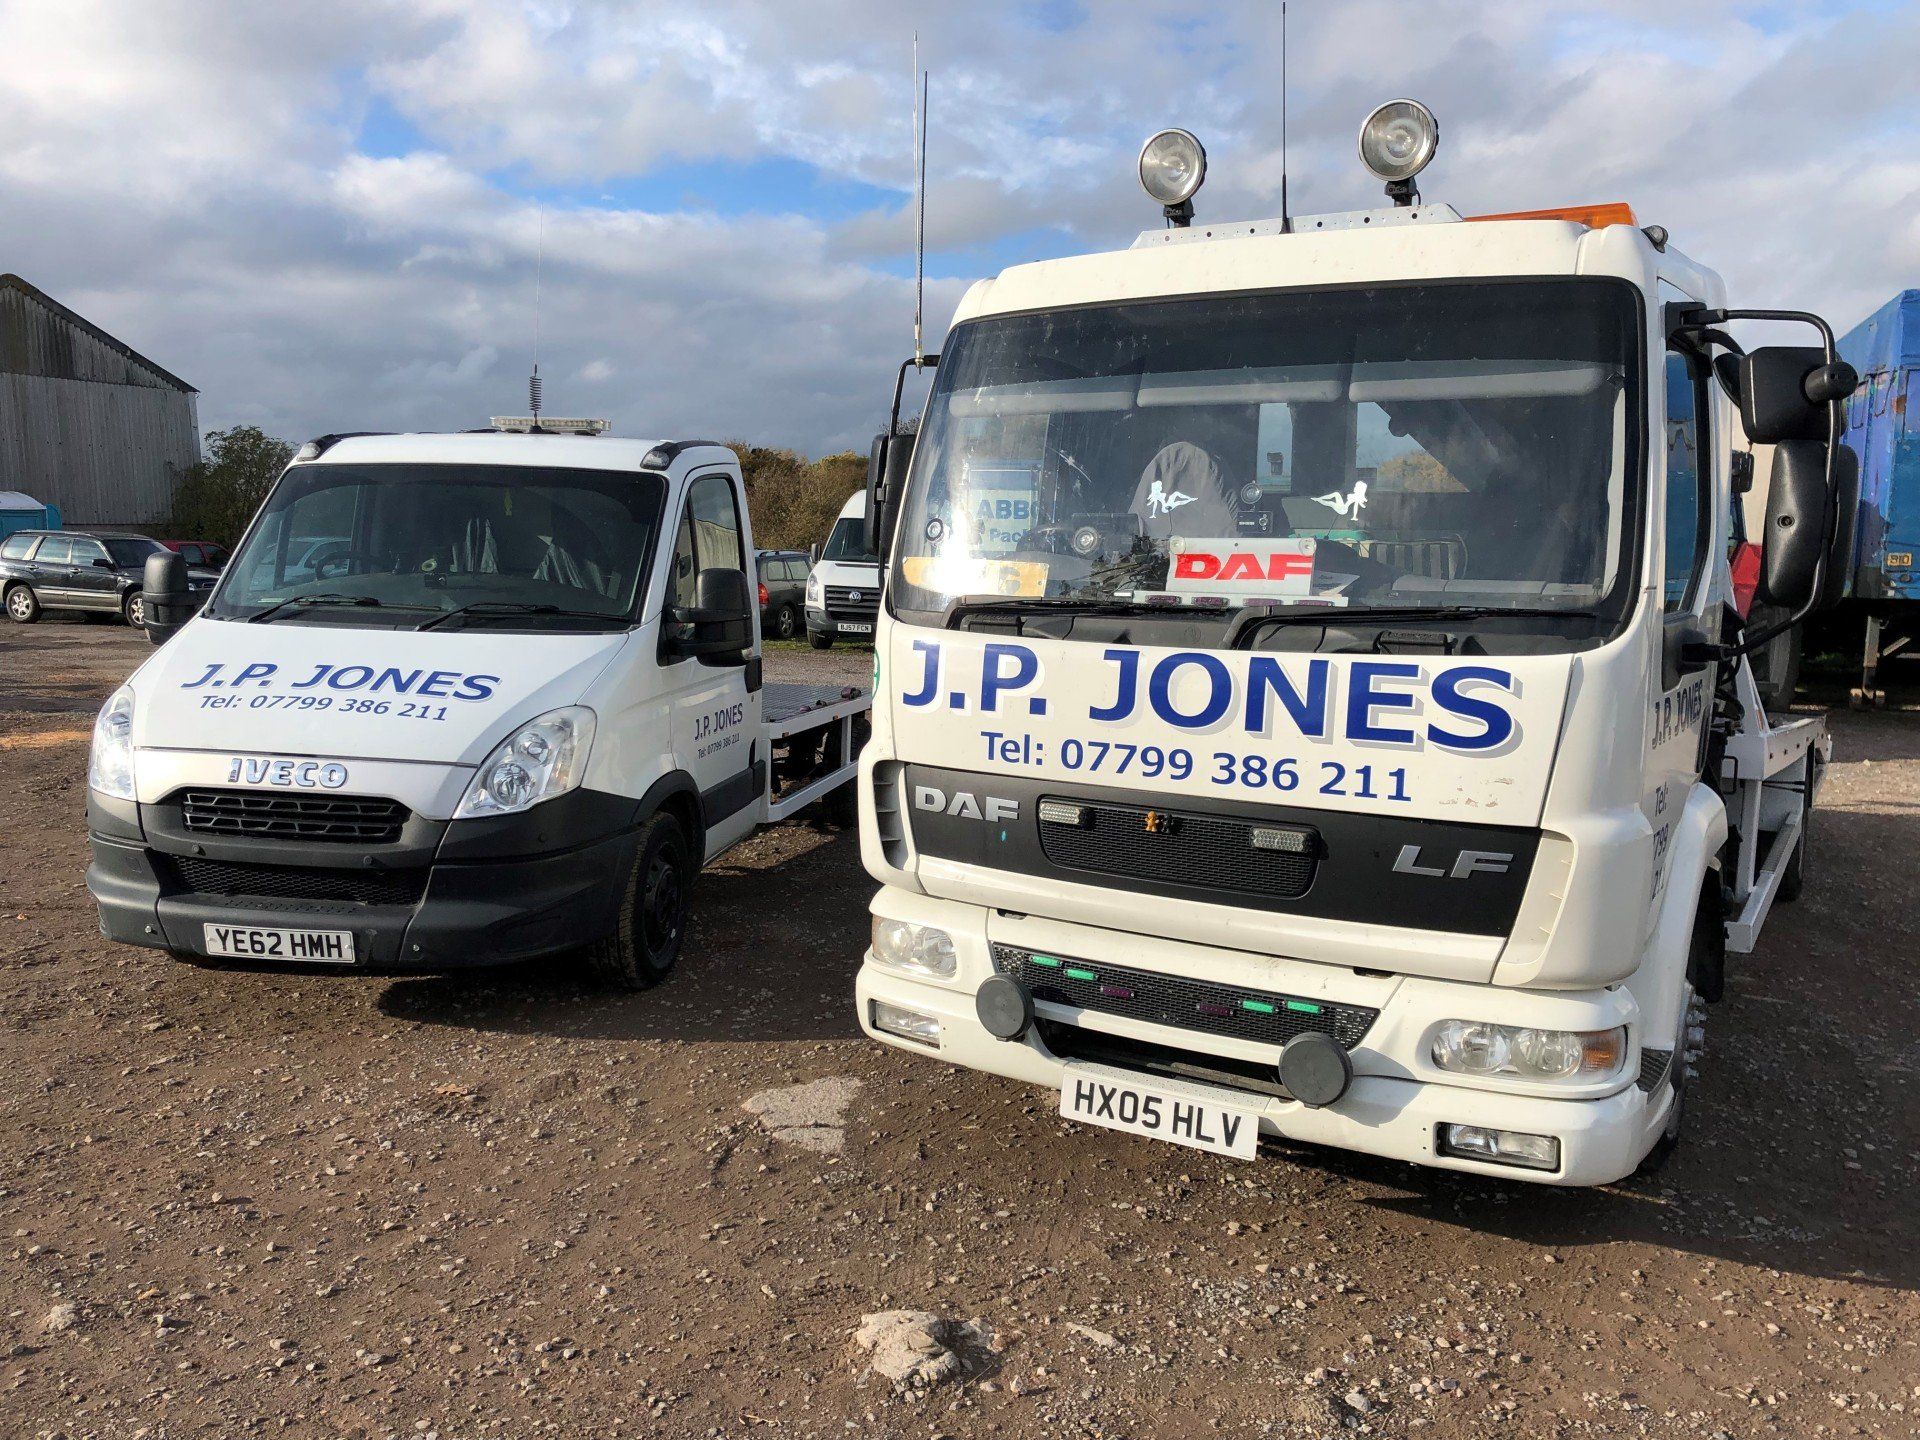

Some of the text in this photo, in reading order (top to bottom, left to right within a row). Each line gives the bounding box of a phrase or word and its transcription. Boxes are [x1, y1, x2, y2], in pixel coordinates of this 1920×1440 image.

[1174, 553, 1313, 581] DAF
[180, 663, 502, 702] J.P. JONES
[902, 639, 1518, 753] J.P. JONES
[199, 694, 449, 722] Tel: 07799 386 211
[694, 702, 743, 741] J.P. JONES
[1674, 678, 1703, 737] JONES
[228, 757, 350, 789] IVECO
[980, 730, 1412, 803] Tel: 07799 386 211
[915, 784, 1020, 823] DAF
[1392, 844, 1515, 880] LF
[214, 927, 343, 959] YE62 HMH
[1074, 1079, 1242, 1149] HX05 HLV
